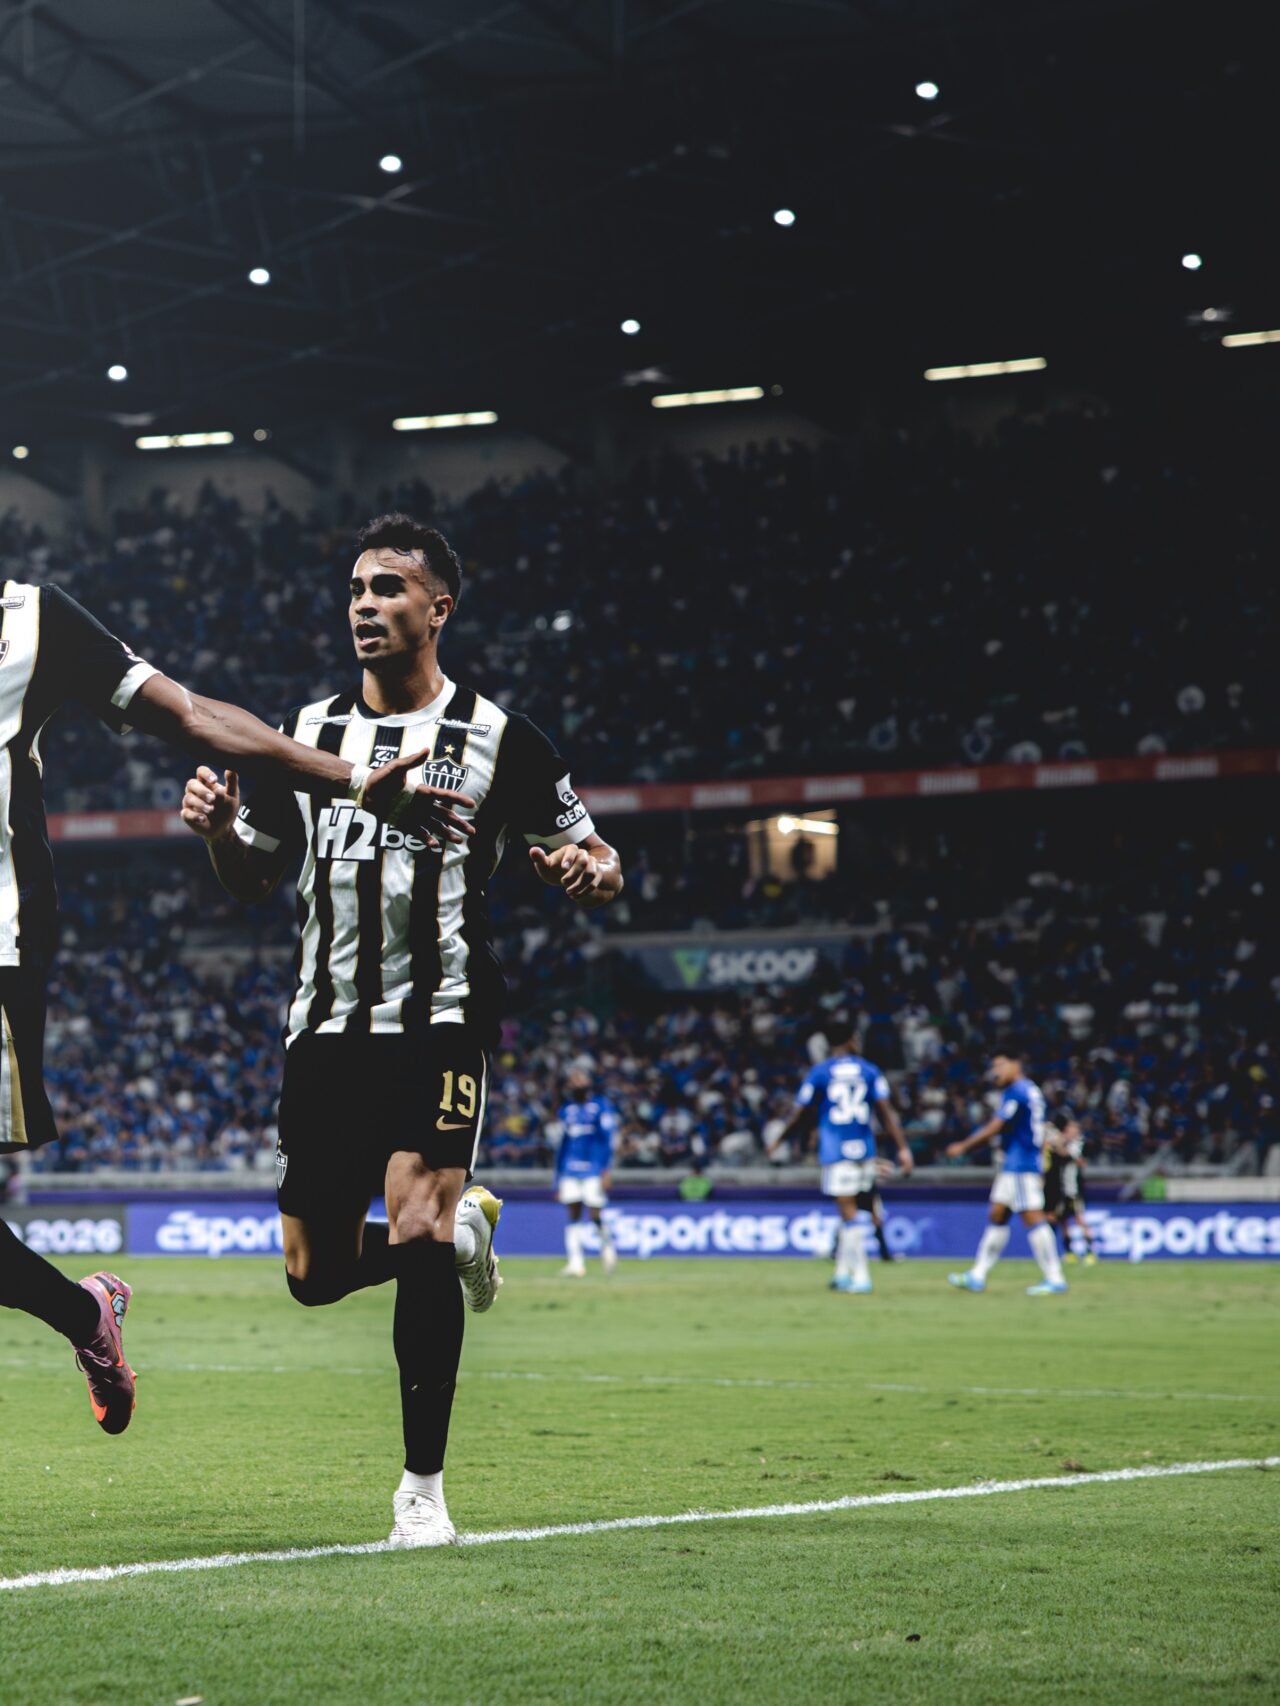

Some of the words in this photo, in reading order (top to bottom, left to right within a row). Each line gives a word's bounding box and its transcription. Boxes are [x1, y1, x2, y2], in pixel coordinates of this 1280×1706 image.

[428, 763, 463, 777] CAM
[439, 1070, 477, 1119] 19
[826, 1078, 870, 1126] 34
[24, 1217, 122, 1254] 2026
